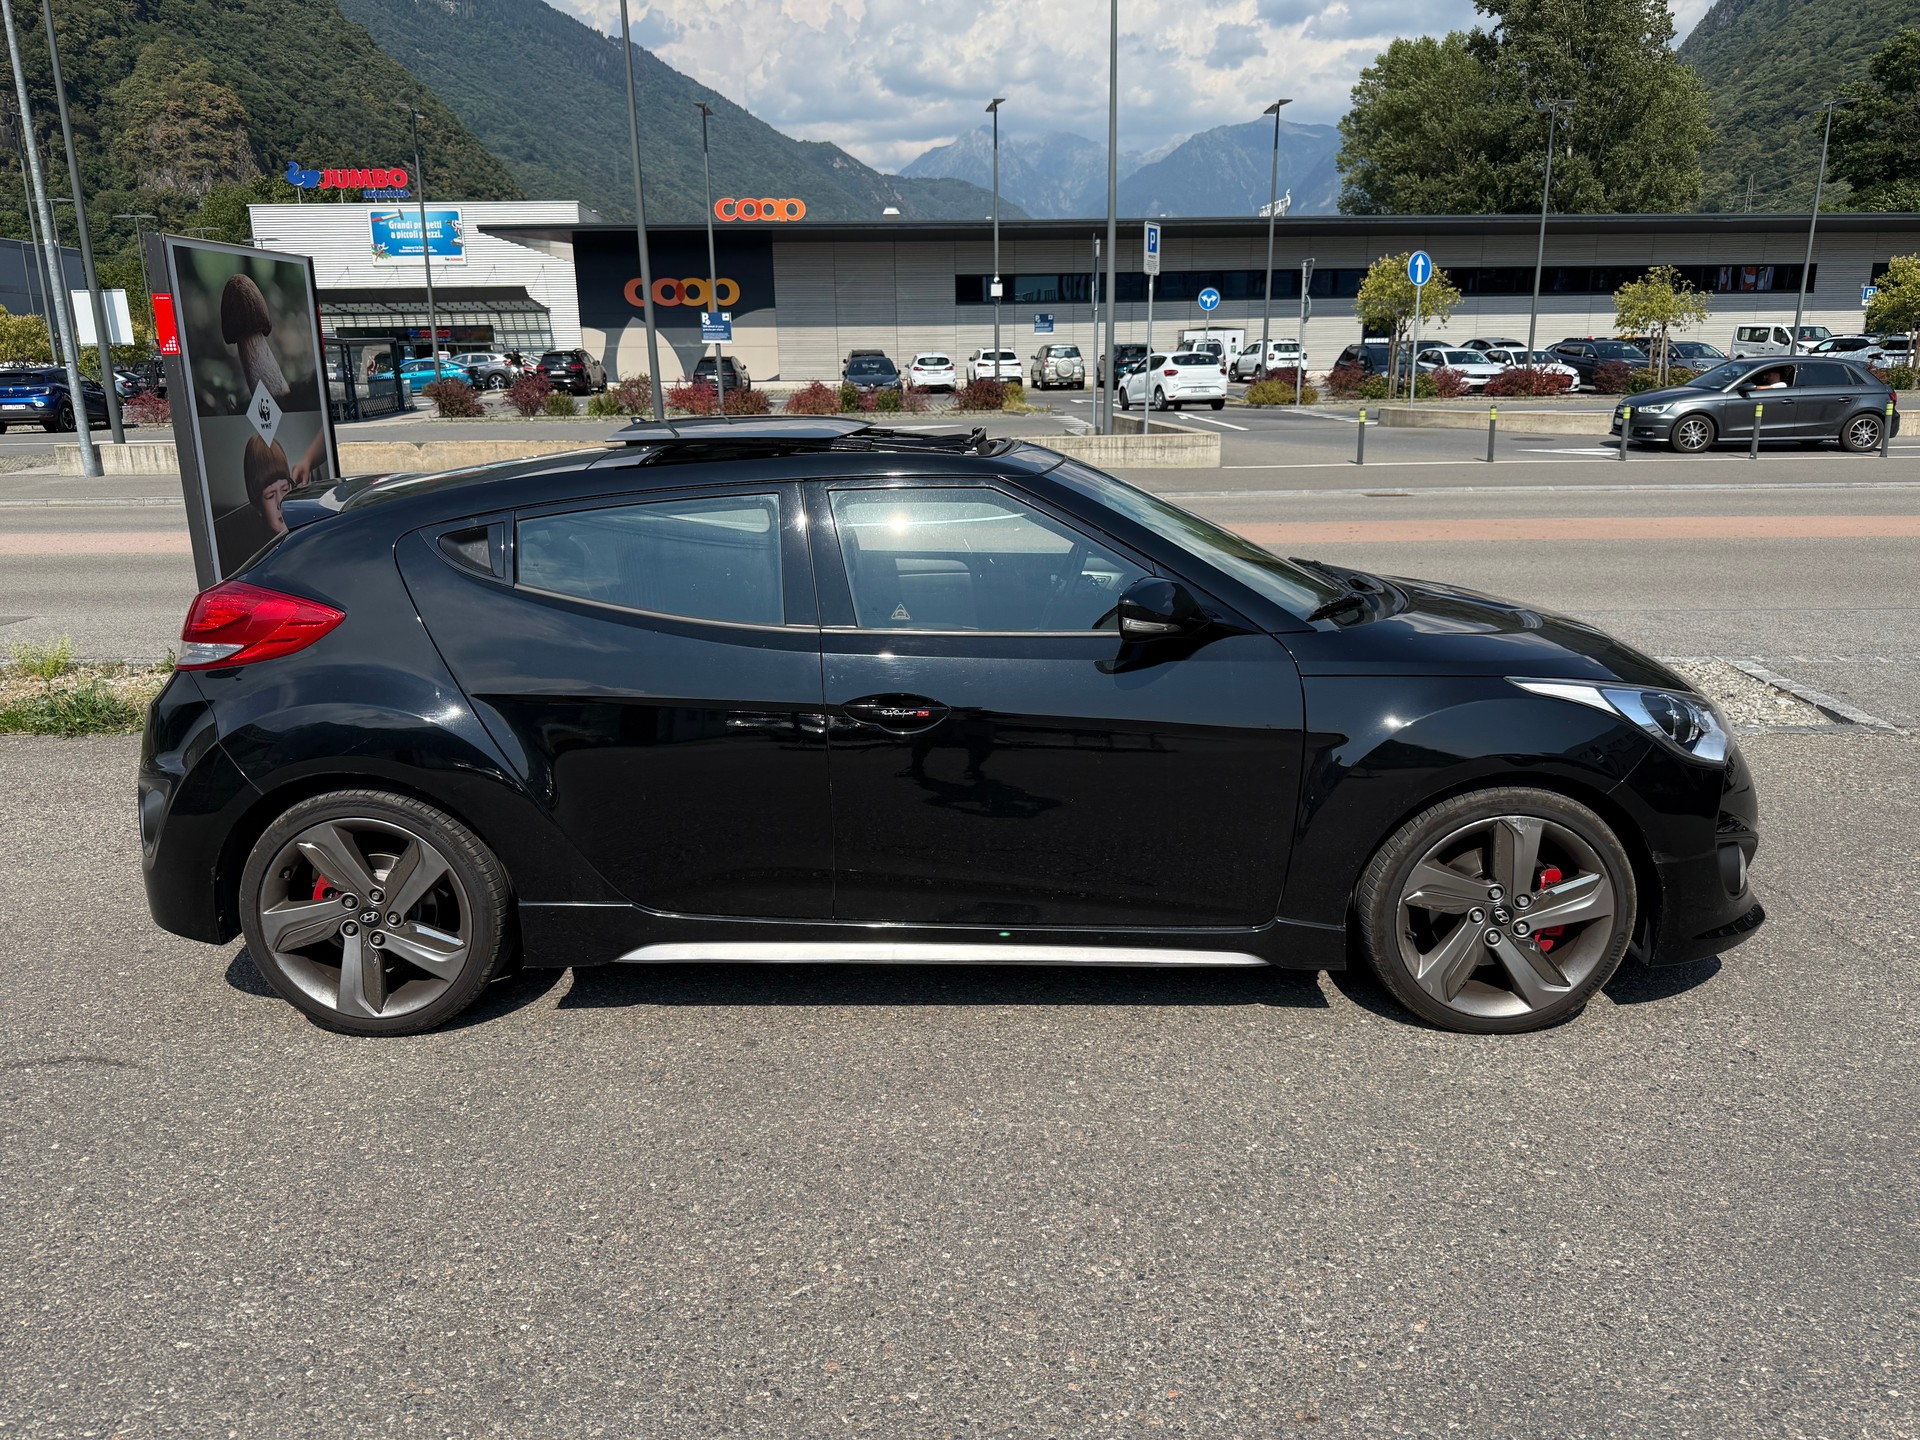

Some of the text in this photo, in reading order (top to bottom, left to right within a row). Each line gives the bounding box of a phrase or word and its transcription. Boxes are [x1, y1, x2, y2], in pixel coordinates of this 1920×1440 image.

[320, 168, 408, 188] JUMBO
[714, 197, 806, 222] coop
[388, 220, 442, 231] Grandi prgetti
[391, 230, 443, 240] a piccoli pezzi.
[1150, 231, 1156, 250] P
[624, 277, 740, 313] coop
[1866, 289, 1874, 299] P
[261, 422, 272, 430] WWF
